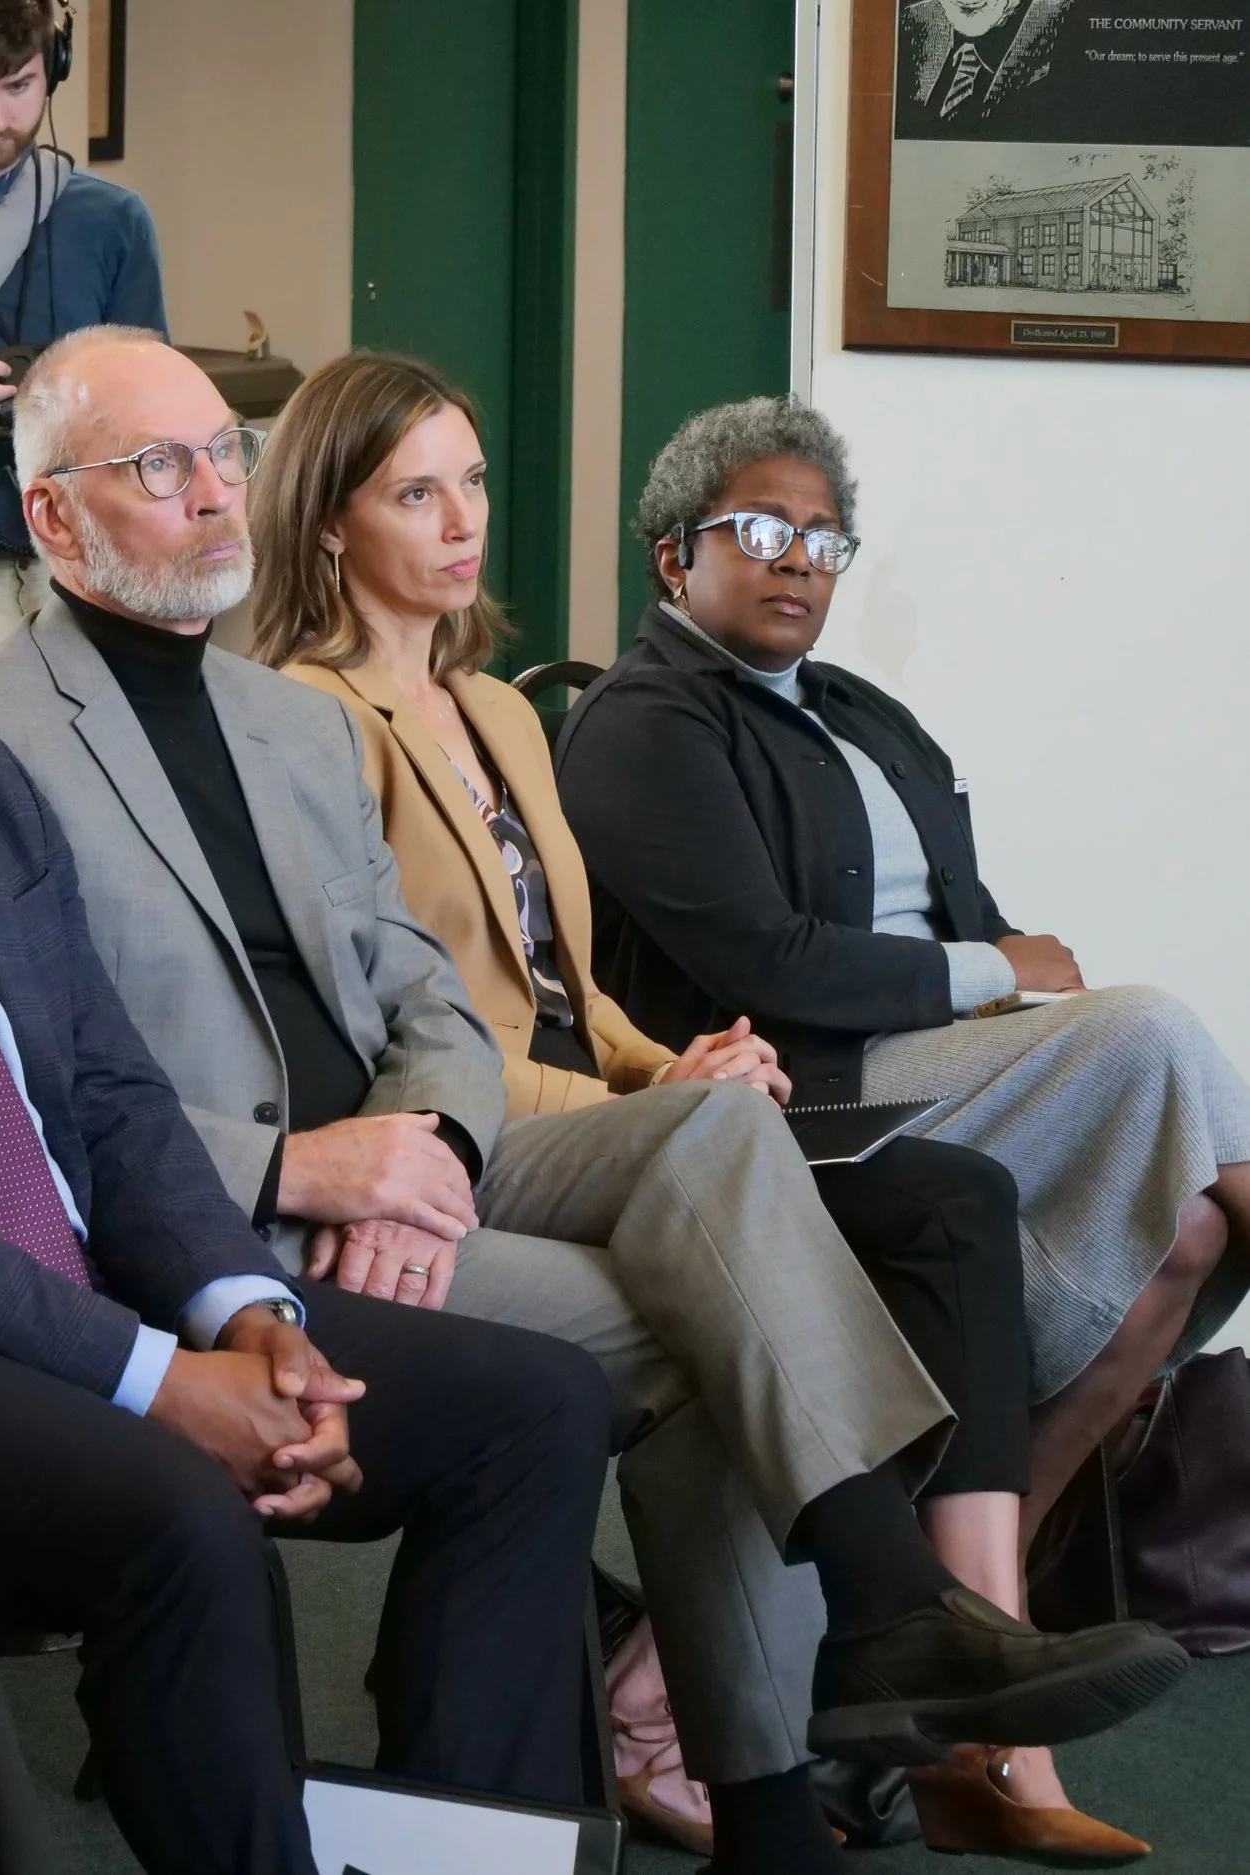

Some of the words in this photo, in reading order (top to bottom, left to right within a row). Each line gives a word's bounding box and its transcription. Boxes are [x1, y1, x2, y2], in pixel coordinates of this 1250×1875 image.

[1088, 17, 1112, 29] THE
[1114, 18, 1188, 30] COMMUNITY
[1190, 19, 1243, 30] SERVANT
[1107, 49, 1136, 62] dream;
[1138, 51, 1147, 62] to
[1149, 53, 1171, 62] serve
[1173, 50, 1188, 62] this
[1189, 52, 1220, 64] present
[1022, 328, 1058, 337] Dedicated
[1059, 329, 1078, 339] April
